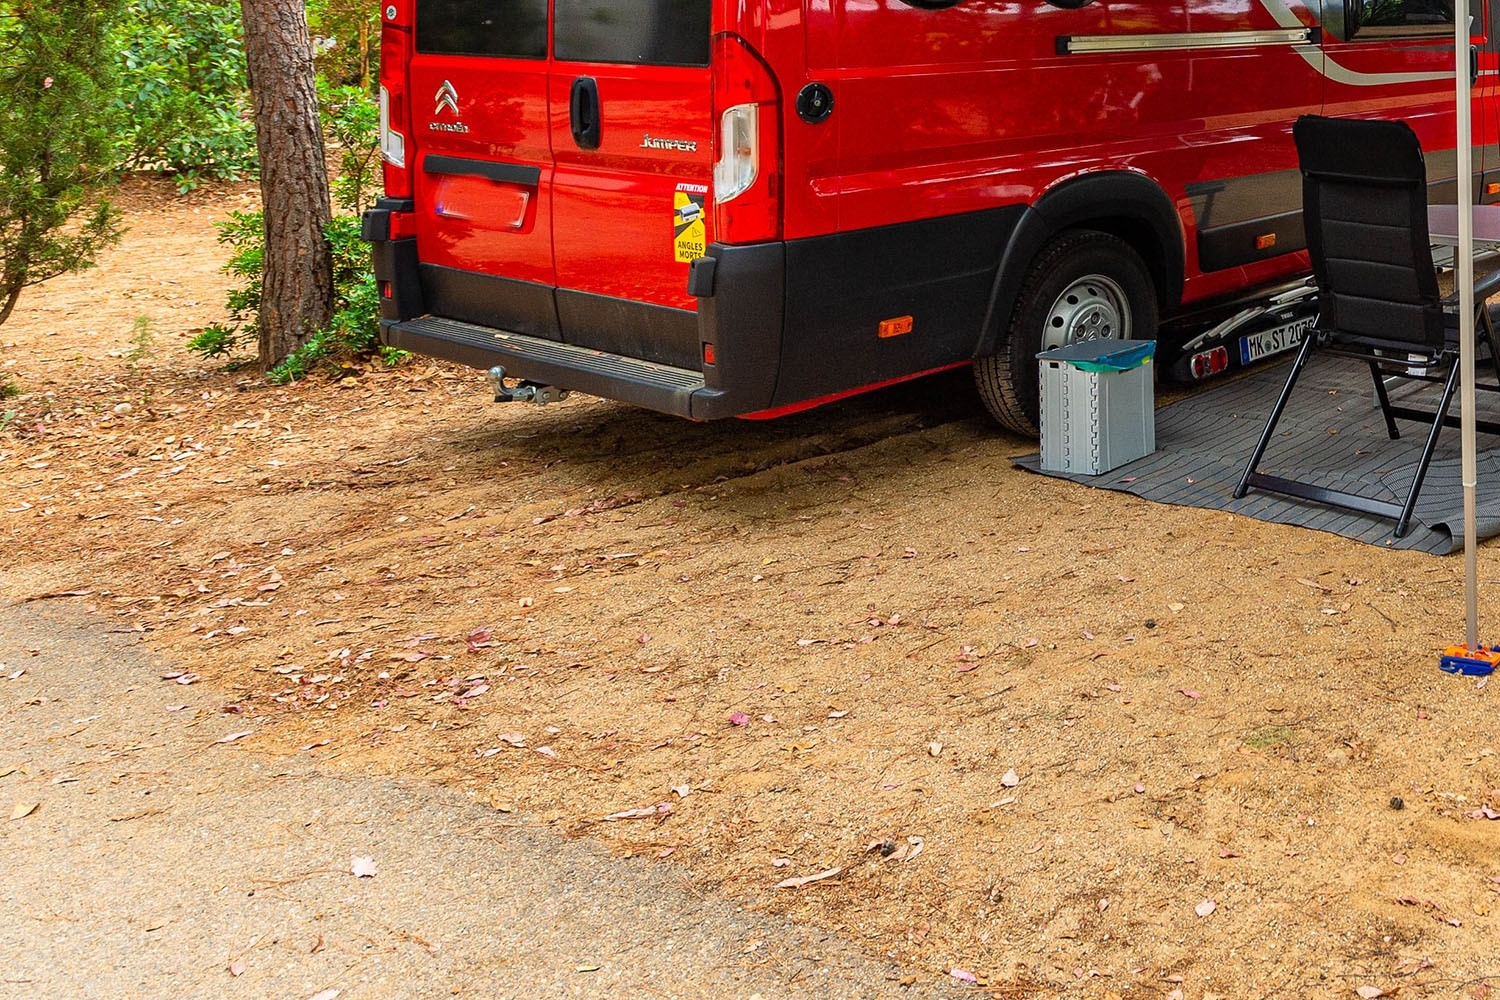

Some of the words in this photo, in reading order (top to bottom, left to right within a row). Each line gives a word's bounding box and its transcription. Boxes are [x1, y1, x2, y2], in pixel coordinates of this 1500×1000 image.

[675, 182, 709, 193] ATTENTION
[678, 241, 703, 251] ANGLES
[679, 251, 702, 259] MORTS
[1249, 336, 1265, 358] MK
[1272, 329, 1286, 350] ST
